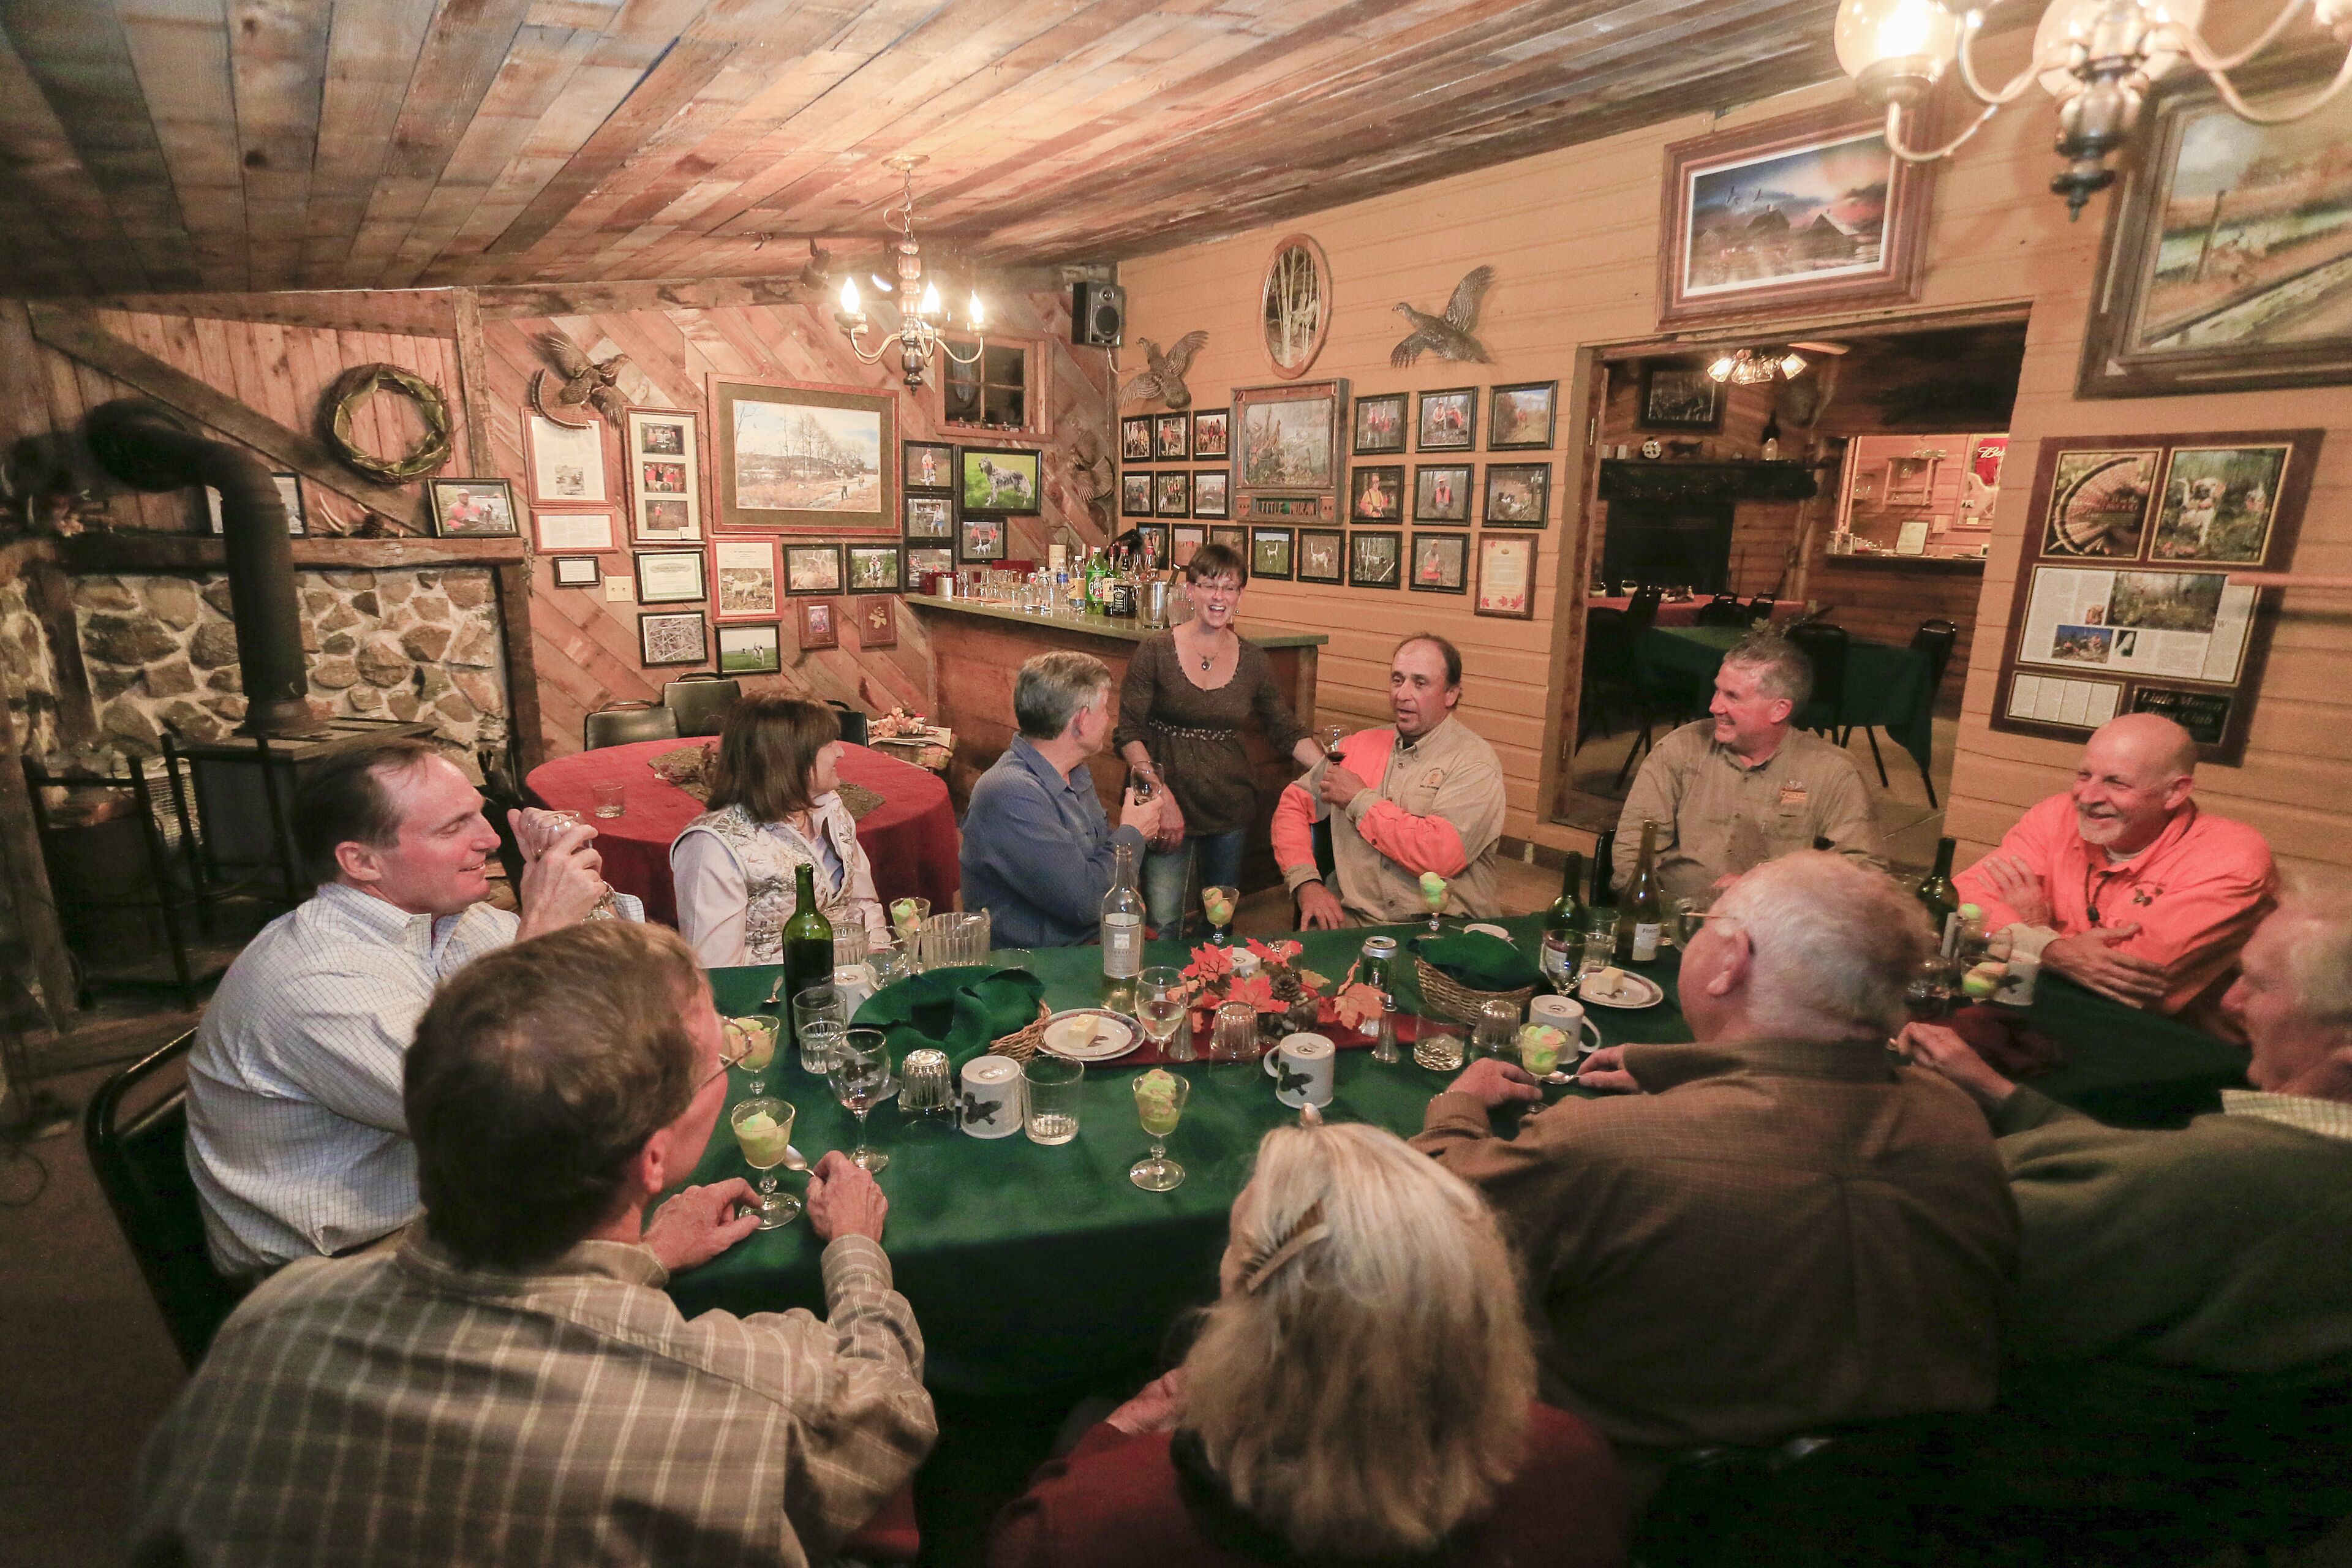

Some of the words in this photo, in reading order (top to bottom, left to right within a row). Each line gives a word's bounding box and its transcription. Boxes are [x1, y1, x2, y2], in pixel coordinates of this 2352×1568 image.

[1256, 501, 1283, 514] LITTLE
[2141, 691, 2175, 705] Little
[2181, 710, 2214, 725] Club
